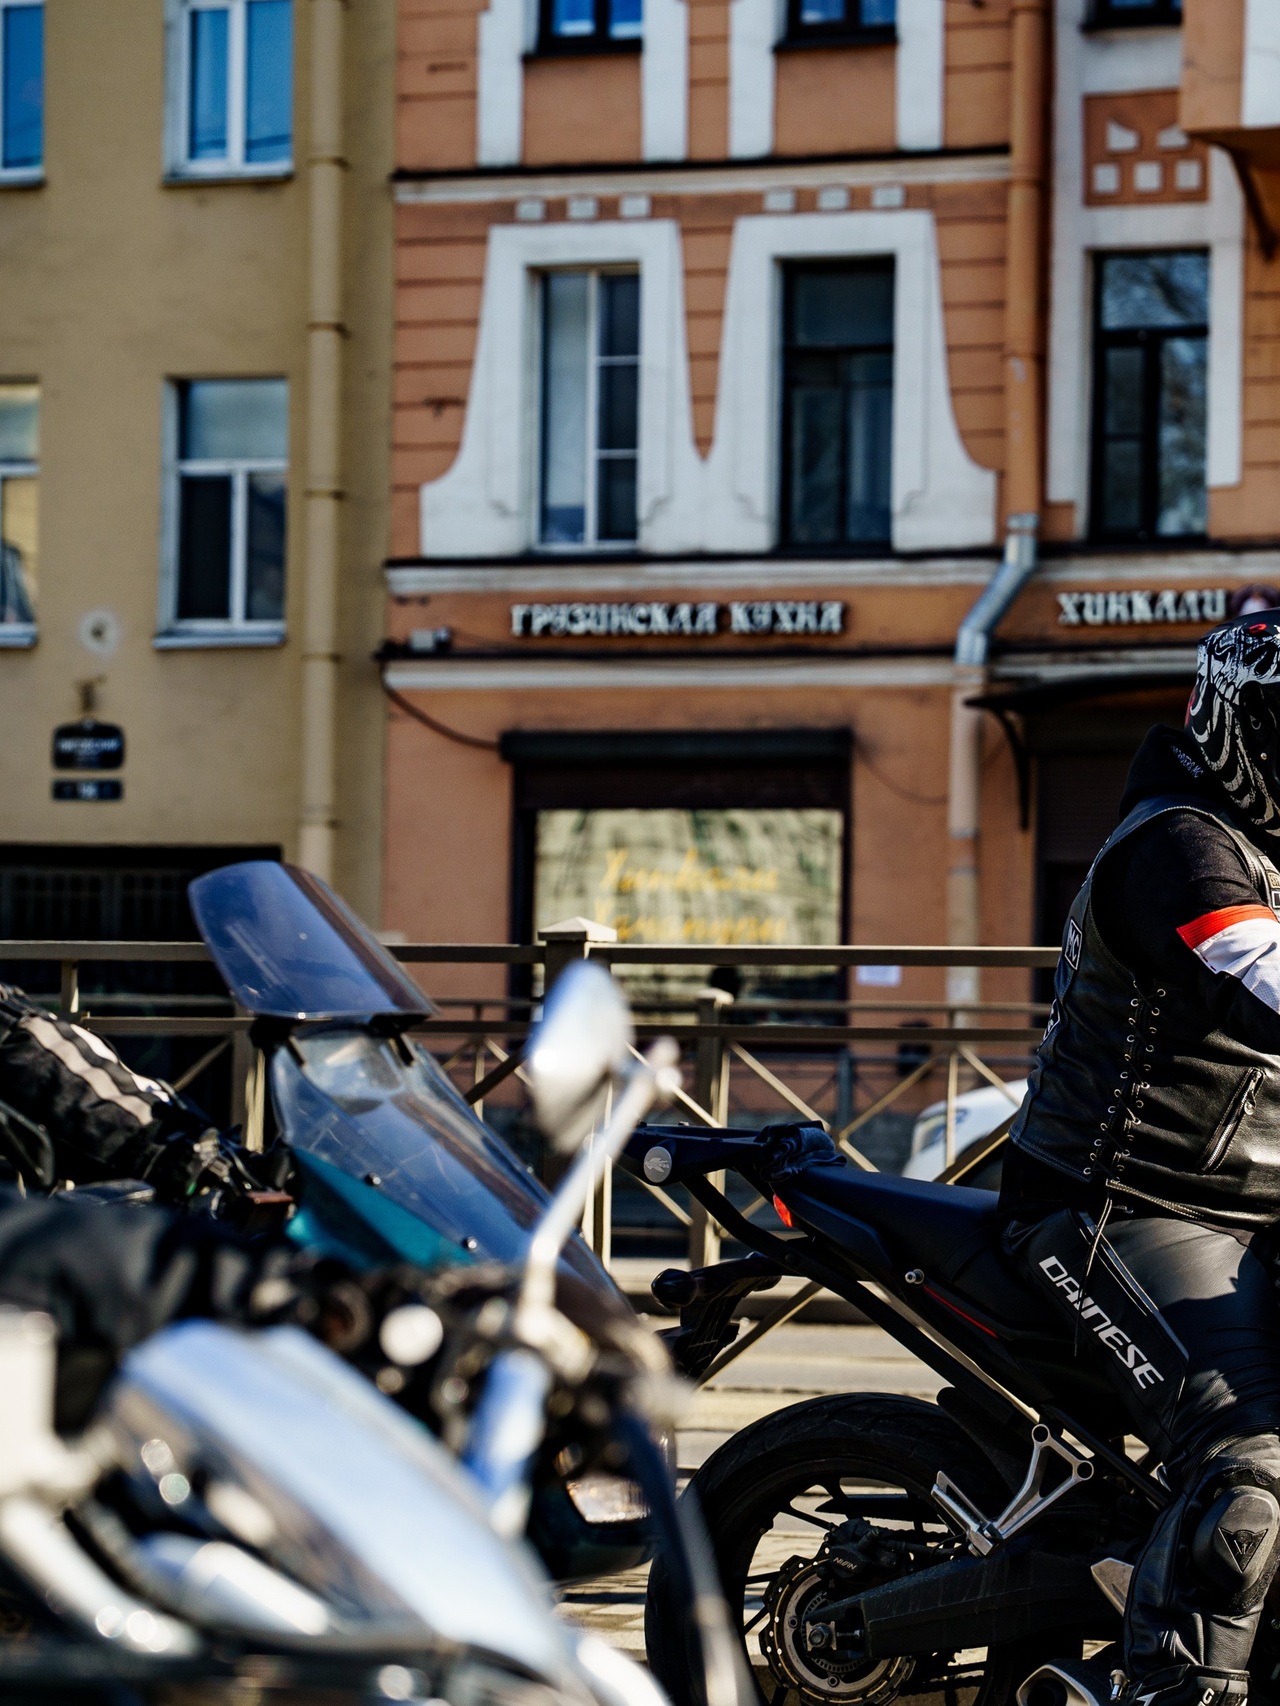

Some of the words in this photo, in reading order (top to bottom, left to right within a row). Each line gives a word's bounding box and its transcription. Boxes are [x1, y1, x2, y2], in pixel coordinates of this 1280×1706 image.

[729, 601, 844, 634] КУХНЯ
[1056, 589, 1227, 625] ХИНКАЛИ
[1038, 1255, 1165, 1390] DAINESE
